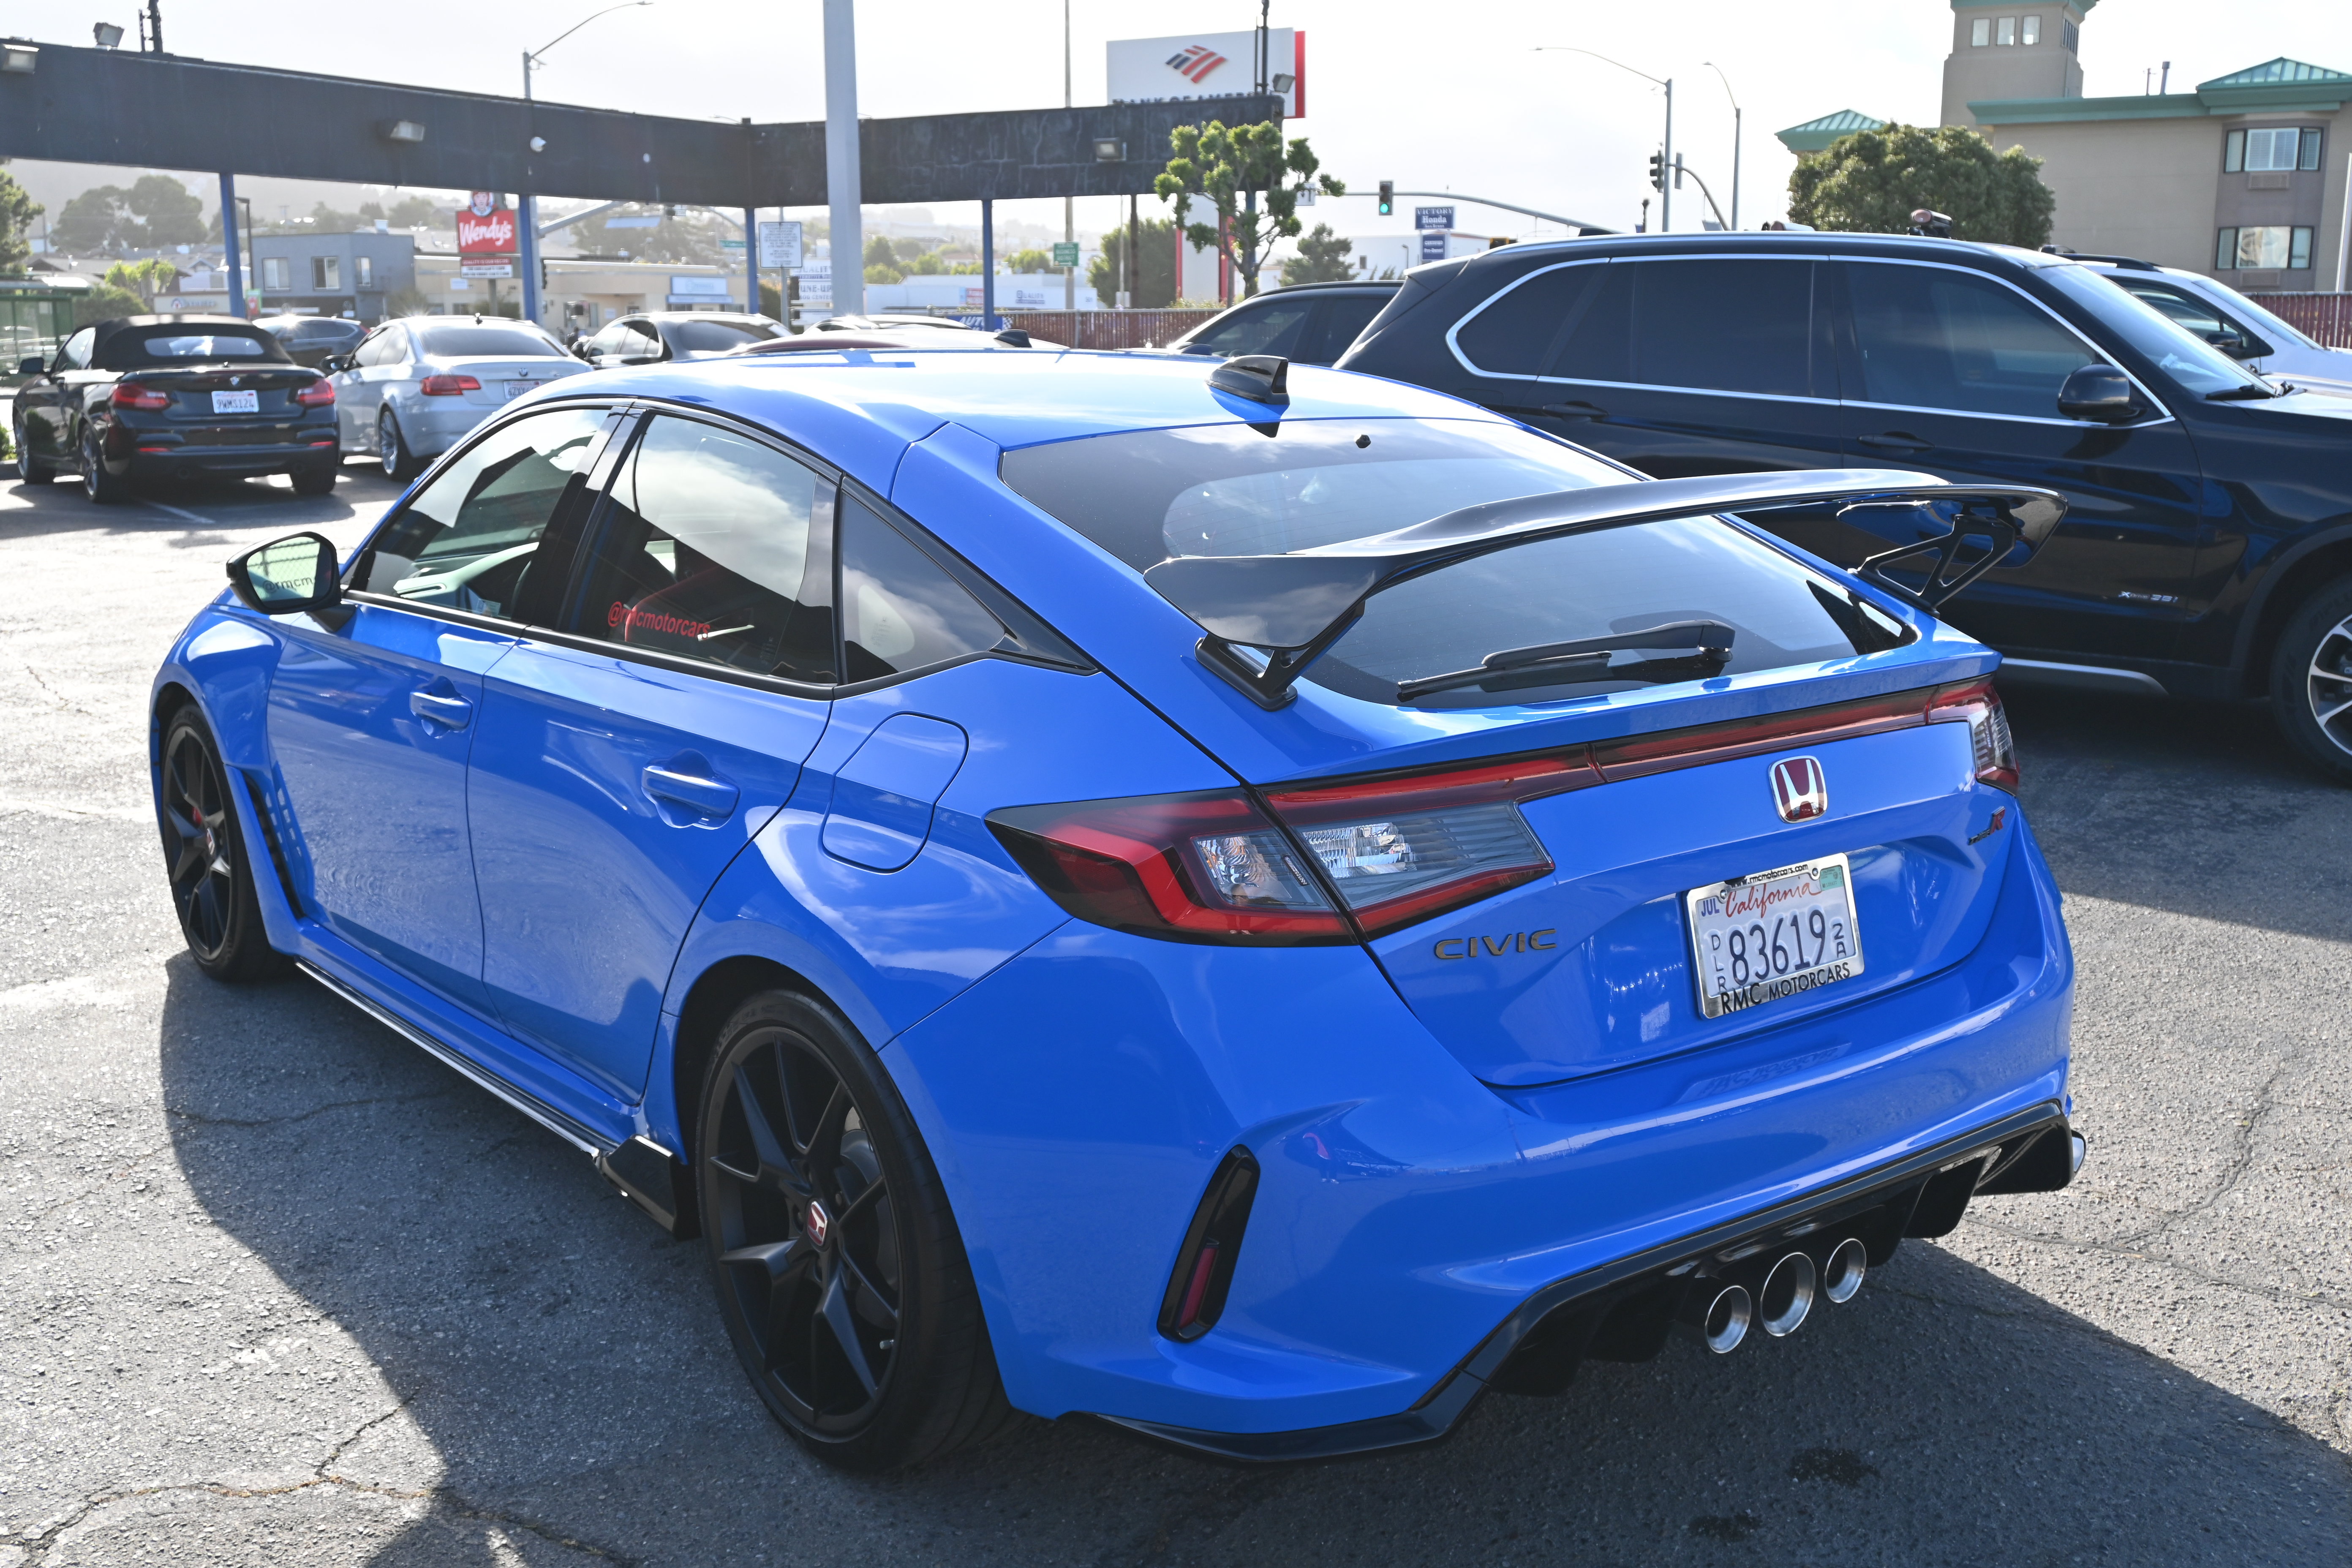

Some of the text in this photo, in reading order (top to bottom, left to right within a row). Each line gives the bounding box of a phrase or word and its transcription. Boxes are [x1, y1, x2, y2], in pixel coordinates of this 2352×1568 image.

[459, 216, 513, 248] Wendy's
[1422, 215, 1447, 223] Honda
[800, 284, 831, 292] UNE-UP
[959, 316, 984, 326] AUT
[1701, 877, 1822, 918] JUL California
[1434, 928, 1557, 959] CIVIC
[1729, 909, 1826, 985] 83619
[1720, 962, 1850, 1014] RMC MOTORCARS
